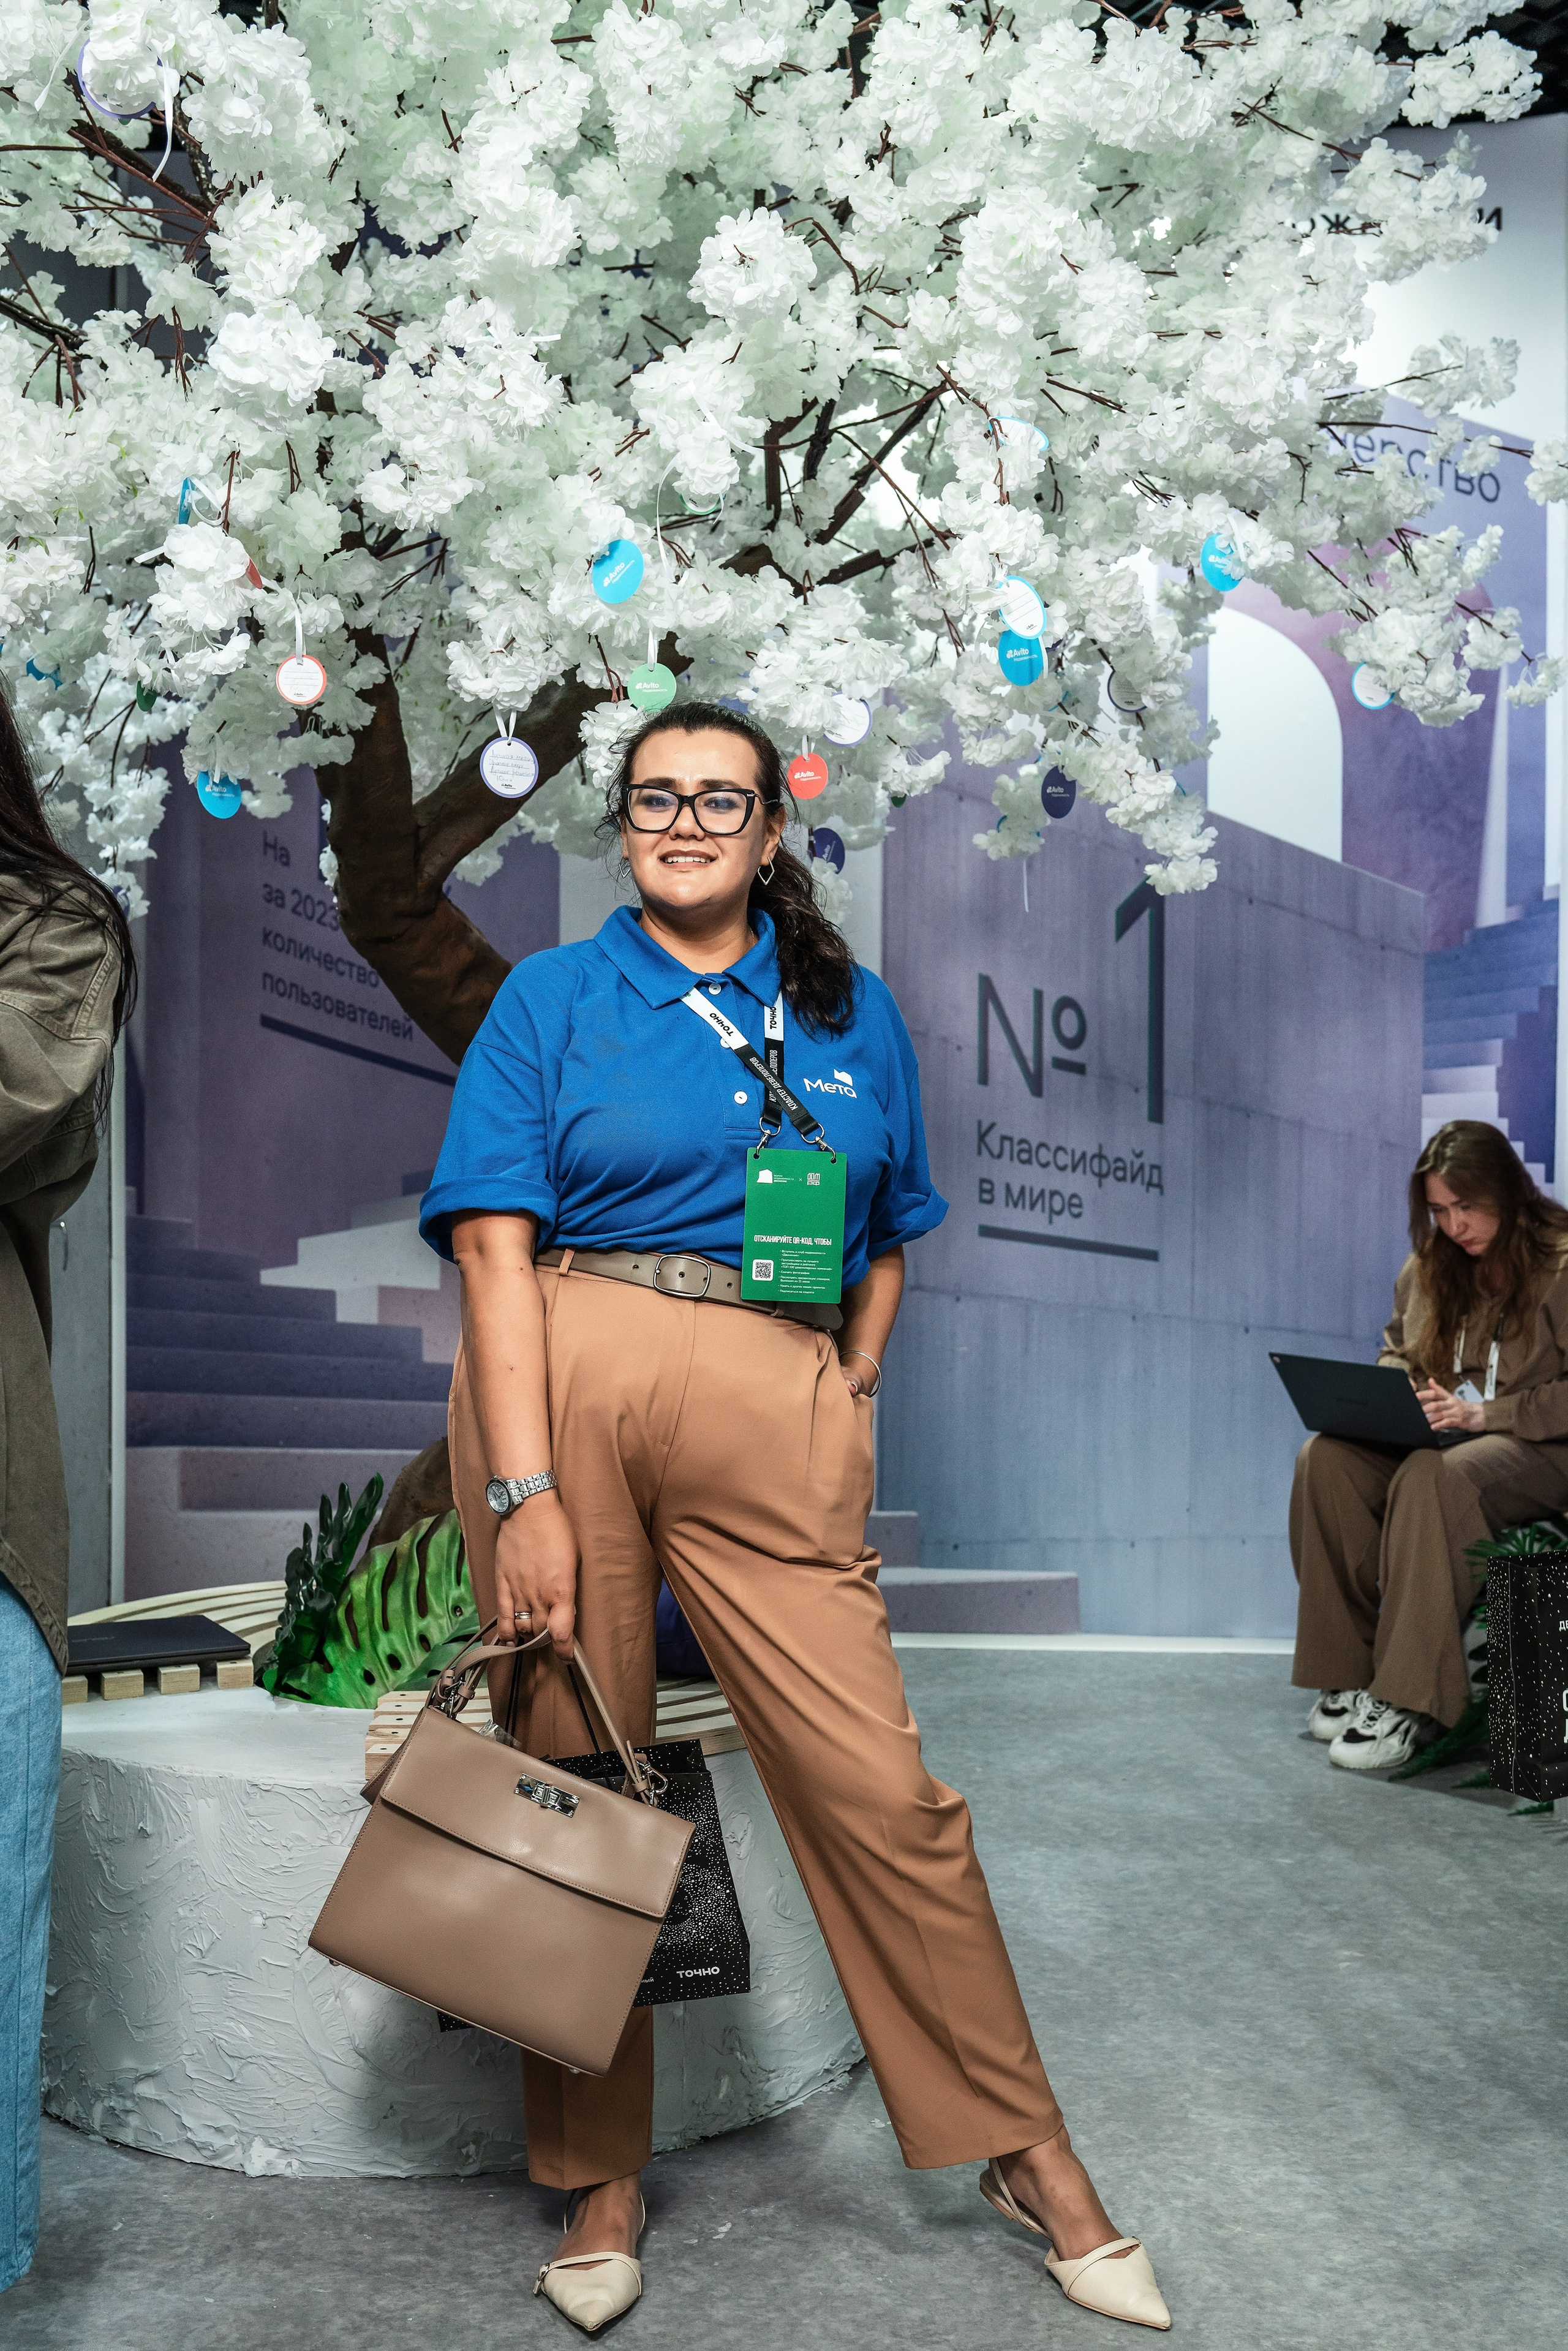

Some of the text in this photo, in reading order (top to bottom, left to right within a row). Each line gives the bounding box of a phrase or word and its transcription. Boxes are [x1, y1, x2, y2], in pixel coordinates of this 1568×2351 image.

[608, 562, 625, 580] Avito
[1012, 647, 1029, 657] Avito
[263, 830, 290, 867] На
[263, 883, 340, 932] за 2023
[263, 927, 380, 989] количество
[262, 972, 414, 1041] пользователей
[709, 1013, 734, 1036] ТОЧНО
[749, 1057, 798, 1111] КЛАСТЕР ДЕВЕЛОПЕРОВ
[803, 1078, 858, 1099] Мета
[977, 1119, 1164, 1196] Классифайд
[979, 1177, 1084, 1225] в мире
[754, 1235, 793, 1243] ОТСКАНИРУЙТЕ
[793, 1237, 813, 1245] QR-КОД,
[676, 1966, 720, 1979] ТОЧНО
